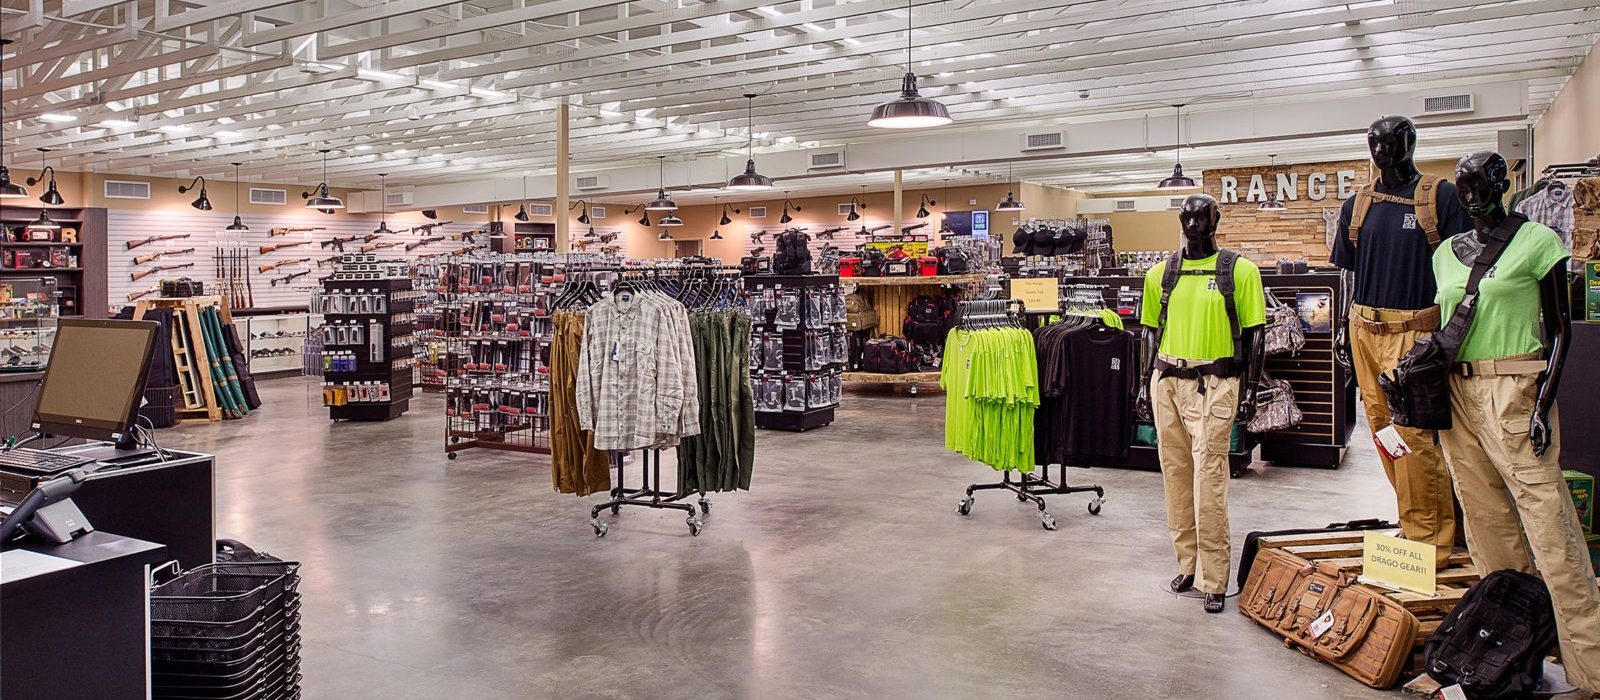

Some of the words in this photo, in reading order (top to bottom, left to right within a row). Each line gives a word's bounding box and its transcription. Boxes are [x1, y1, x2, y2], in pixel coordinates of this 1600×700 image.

[1220, 170, 1356, 204] RANGE
[1376, 543, 1391, 554] 30%
[1392, 547, 1408, 557] OFF
[1409, 551, 1423, 561] ALL
[1371, 554, 1399, 568] DRAGO
[1399, 562, 1427, 575] GEAR!!
